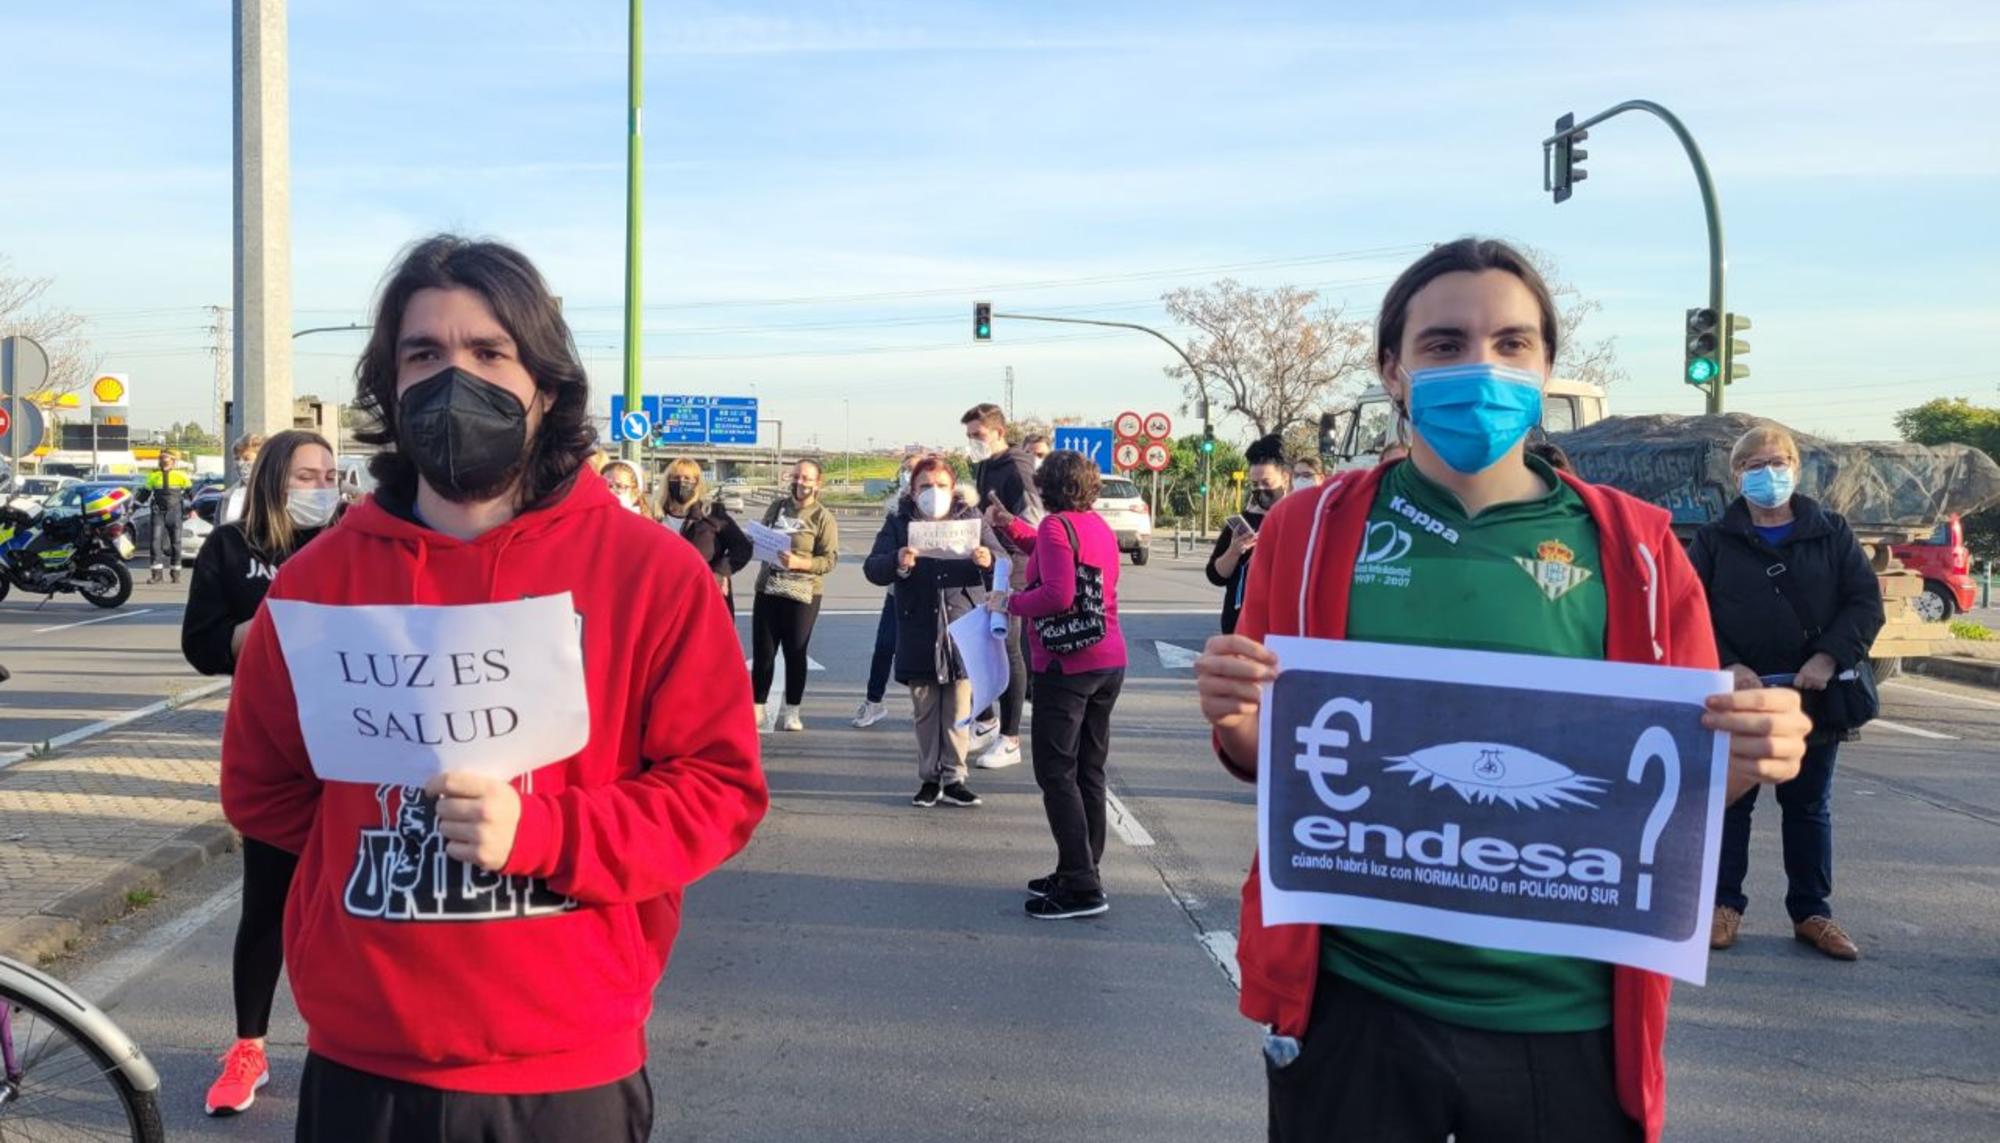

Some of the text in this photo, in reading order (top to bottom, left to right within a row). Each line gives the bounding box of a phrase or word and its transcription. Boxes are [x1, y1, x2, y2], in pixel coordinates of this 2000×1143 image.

[1389, 495, 1459, 544] Kappa
[336, 648, 510, 688] LUZ ES
[352, 705, 519, 745] SALUD
[1626, 725, 1681, 912] ?
[1292, 814, 1622, 885] endesa
[1336, 855, 1368, 875] habrá
[1370, 860, 1388, 878] luz
[1390, 865, 1411, 880] con
[1414, 867, 1498, 893] NORMALIDAD
[1501, 881, 1516, 895] en
[1519, 879, 1588, 902] POLÍGONO
[1590, 886, 1619, 905] SUR
